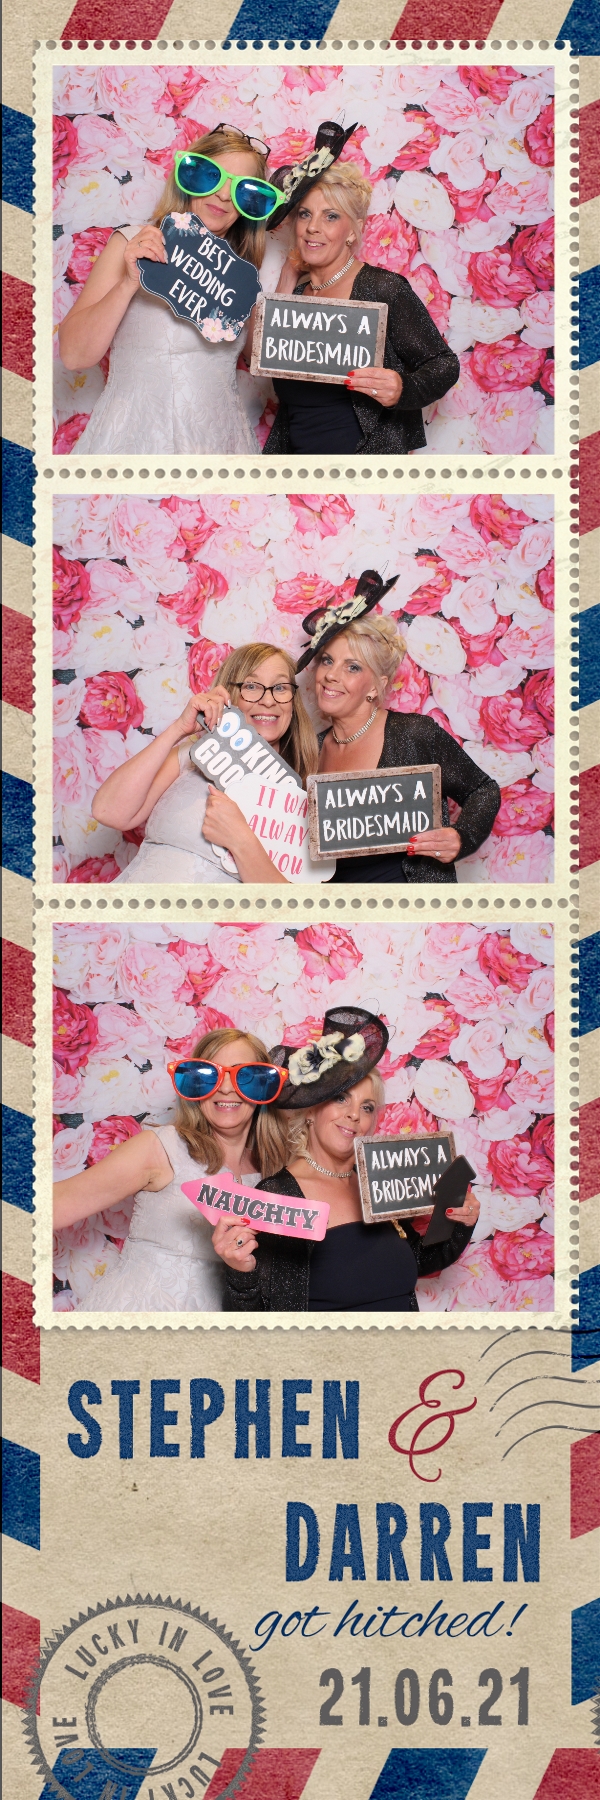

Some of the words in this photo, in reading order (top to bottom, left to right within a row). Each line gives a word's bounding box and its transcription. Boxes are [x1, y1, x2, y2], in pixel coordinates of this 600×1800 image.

[198, 237, 236, 275] BEST
[170, 245, 236, 307] WEDDING
[168, 278, 208, 322] EVER
[270, 307, 348, 334] ALWAYS
[357, 315, 371, 335] A
[265, 336, 371, 368] BRIDESMAID
[194, 738, 244, 789] GOO
[256, 785, 279, 808] IT
[284, 792, 308, 818] WA
[324, 783, 403, 809] ALWAYS
[413, 780, 427, 800] A
[248, 814, 310, 847] ALWAY
[322, 811, 430, 842] BRIDESMAID
[371, 1146, 431, 1170] ALWAYS
[437, 1144, 447, 1163] A
[371, 1173, 442, 1204] BRIDESM
[196, 1183, 319, 1230] NAUGHTY
